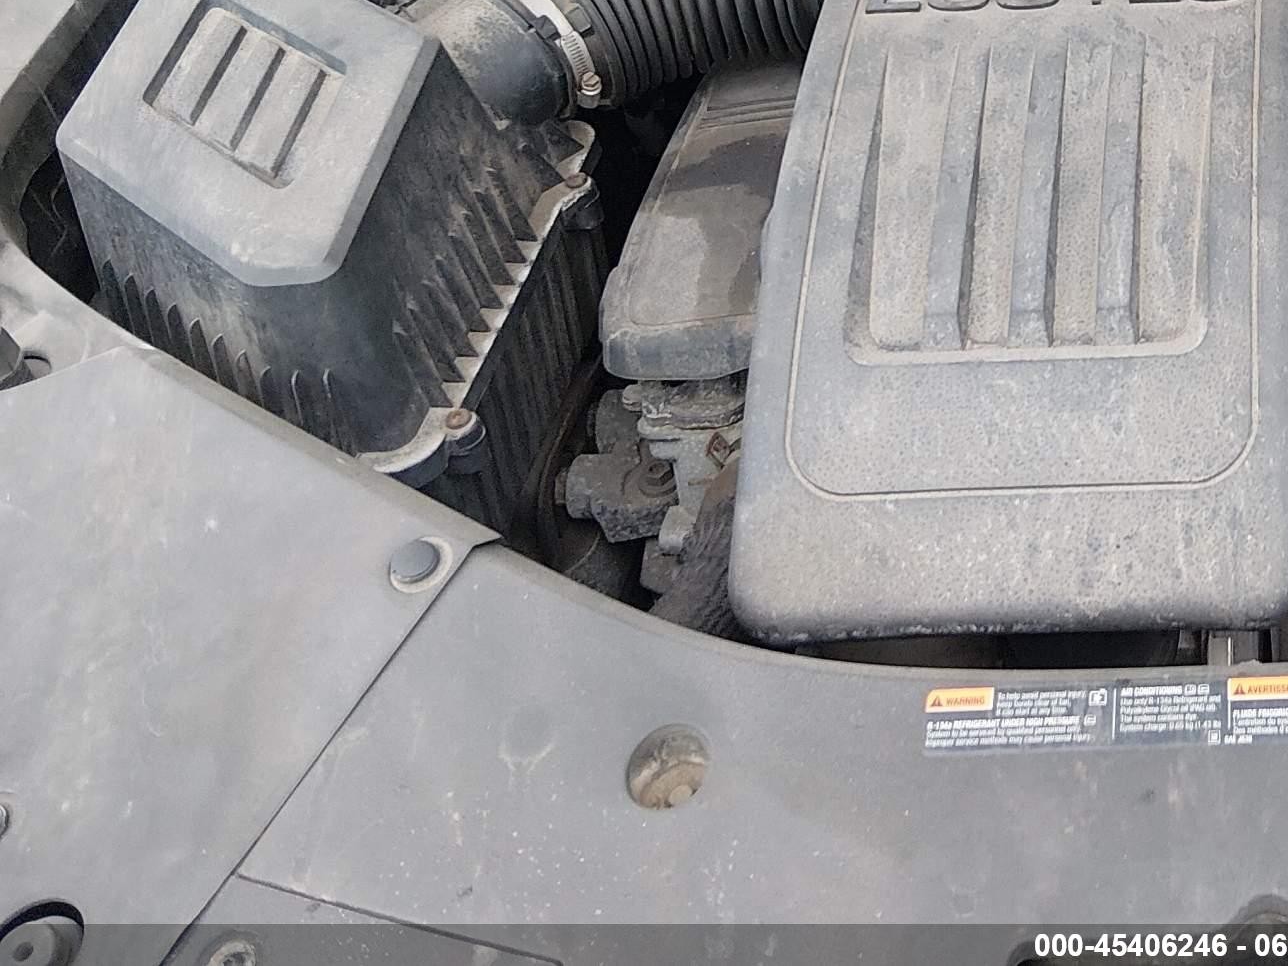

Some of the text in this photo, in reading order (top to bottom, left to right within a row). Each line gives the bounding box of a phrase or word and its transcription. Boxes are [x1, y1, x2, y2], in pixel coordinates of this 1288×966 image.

[1121, 685, 1182, 697] AIR CONDITIONING
[946, 695, 986, 706] WARNING
